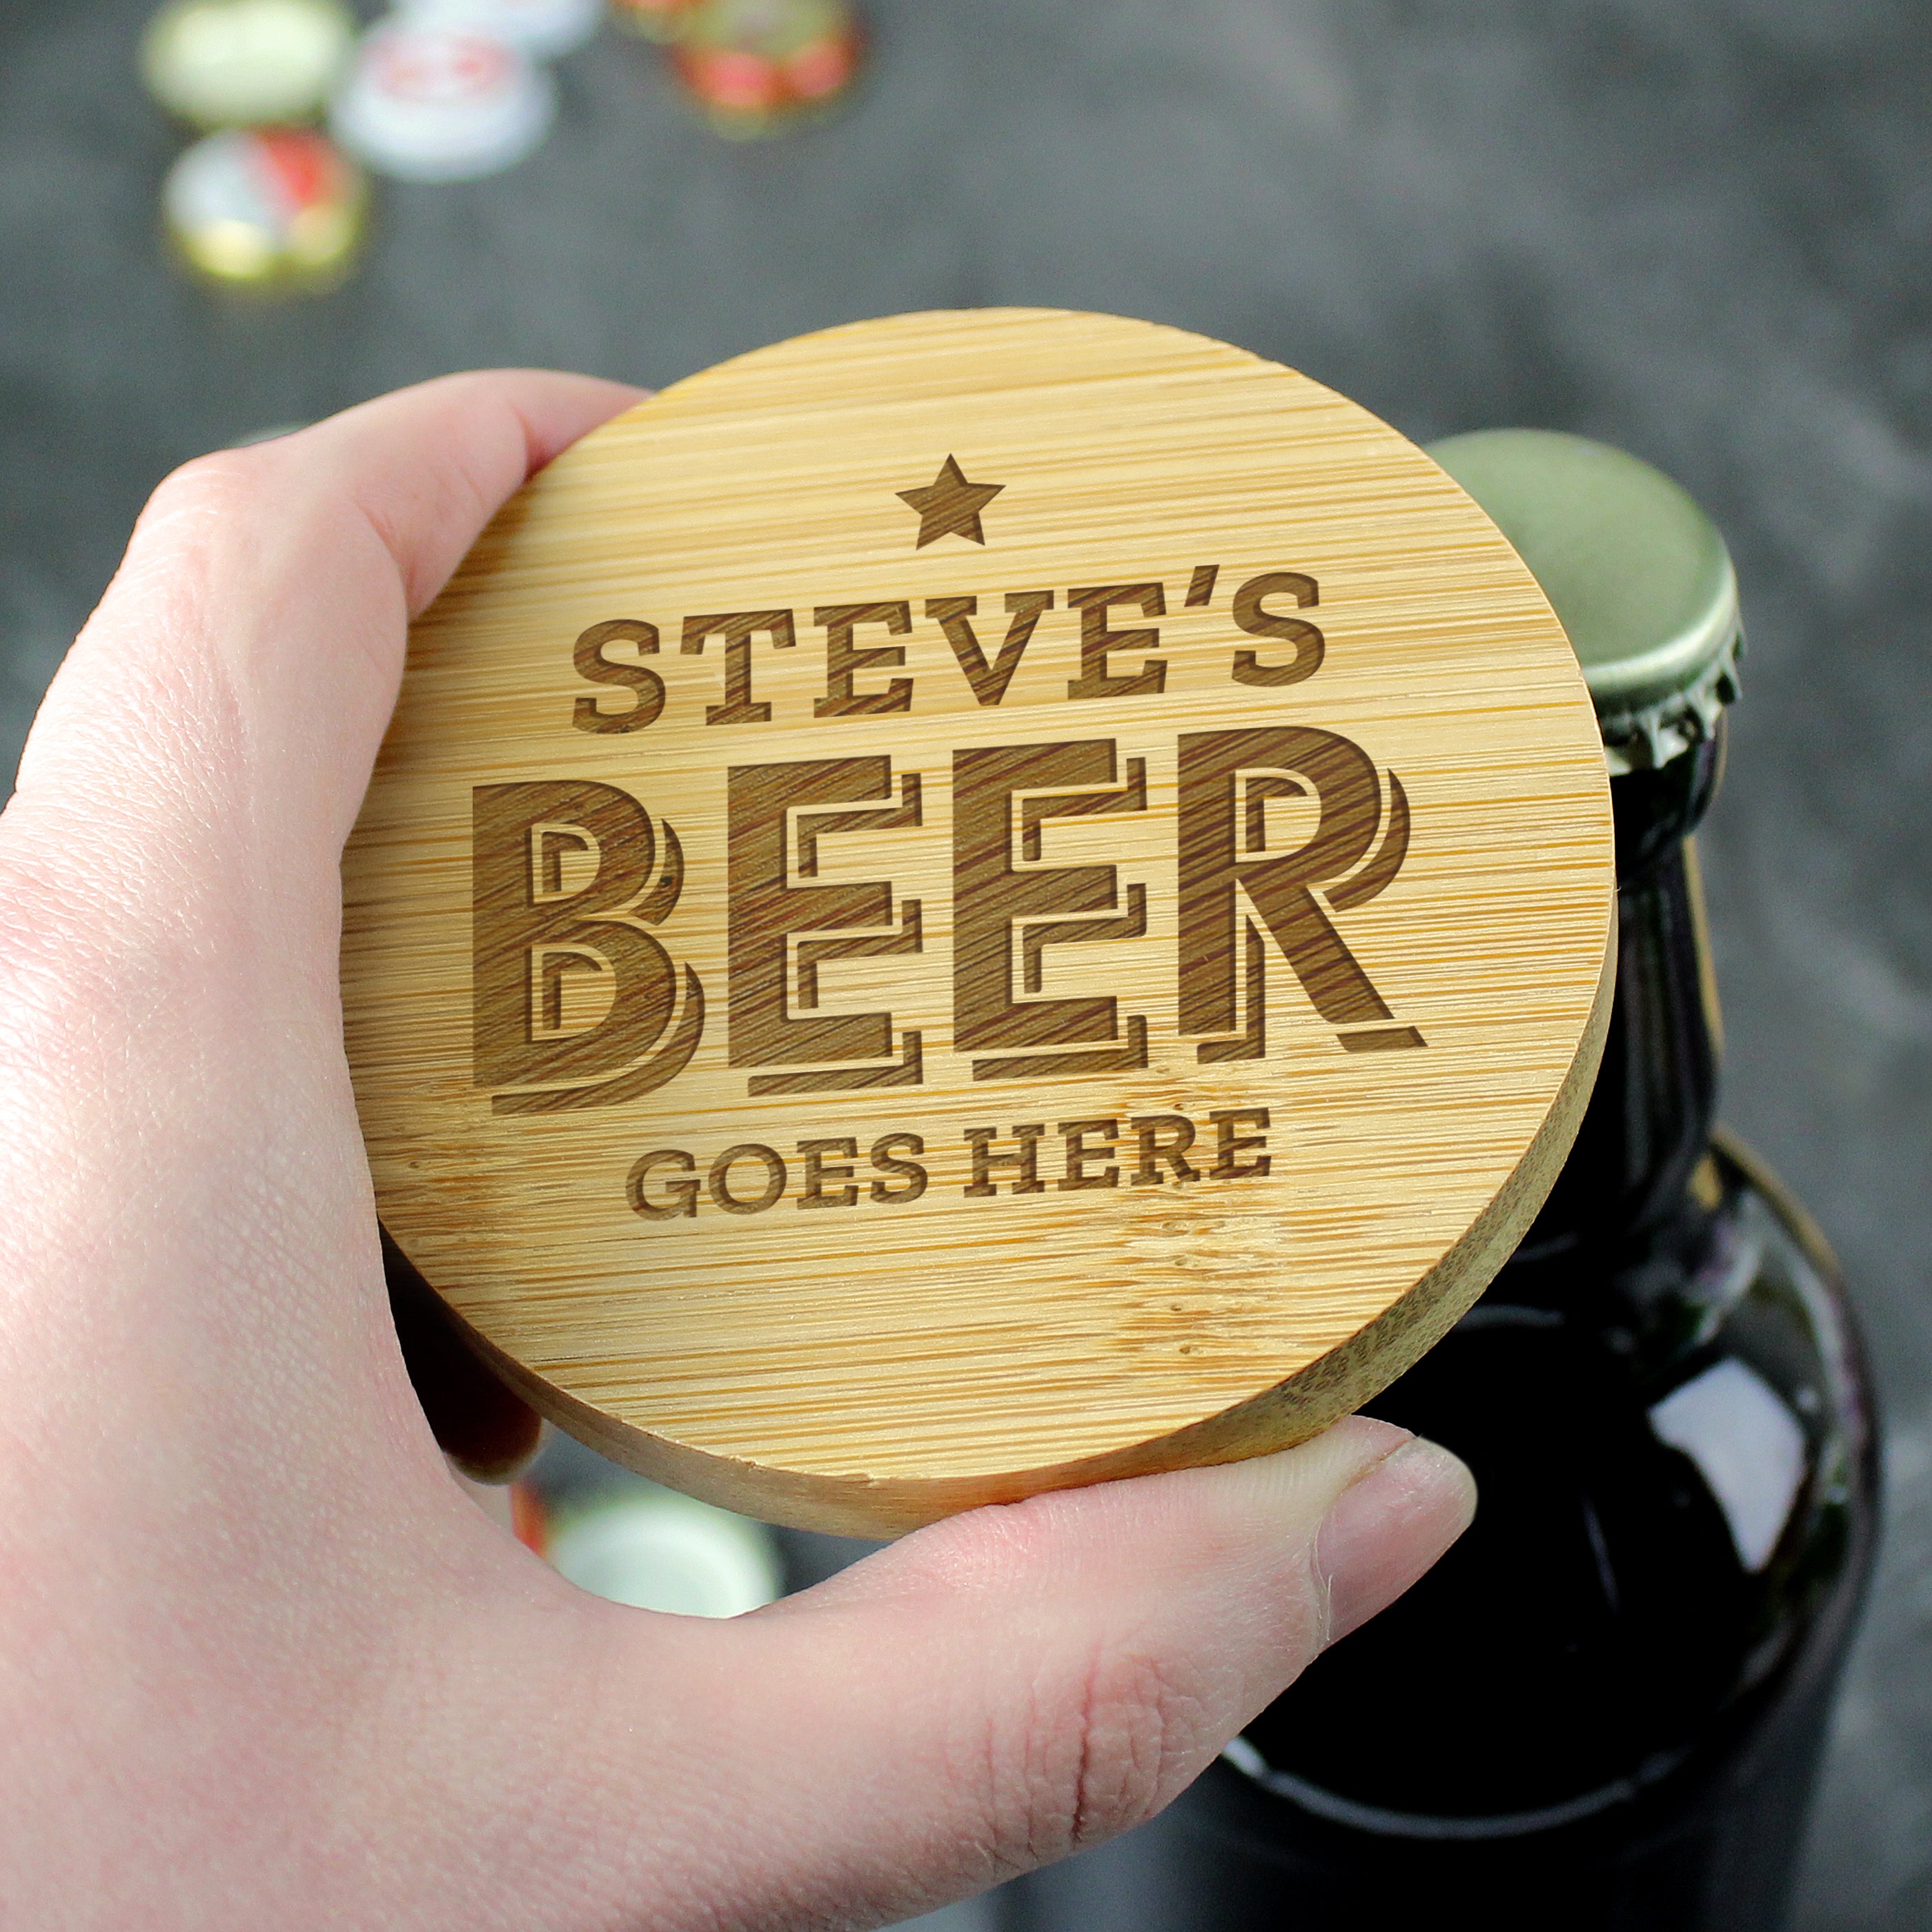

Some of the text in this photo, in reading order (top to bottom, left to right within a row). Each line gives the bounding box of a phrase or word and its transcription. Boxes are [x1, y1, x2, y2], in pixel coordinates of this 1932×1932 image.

[572, 564, 1325, 735] STEVE'S
[472, 726, 1428, 1114] BEER
[625, 1107, 1271, 1221] GOES HERE
